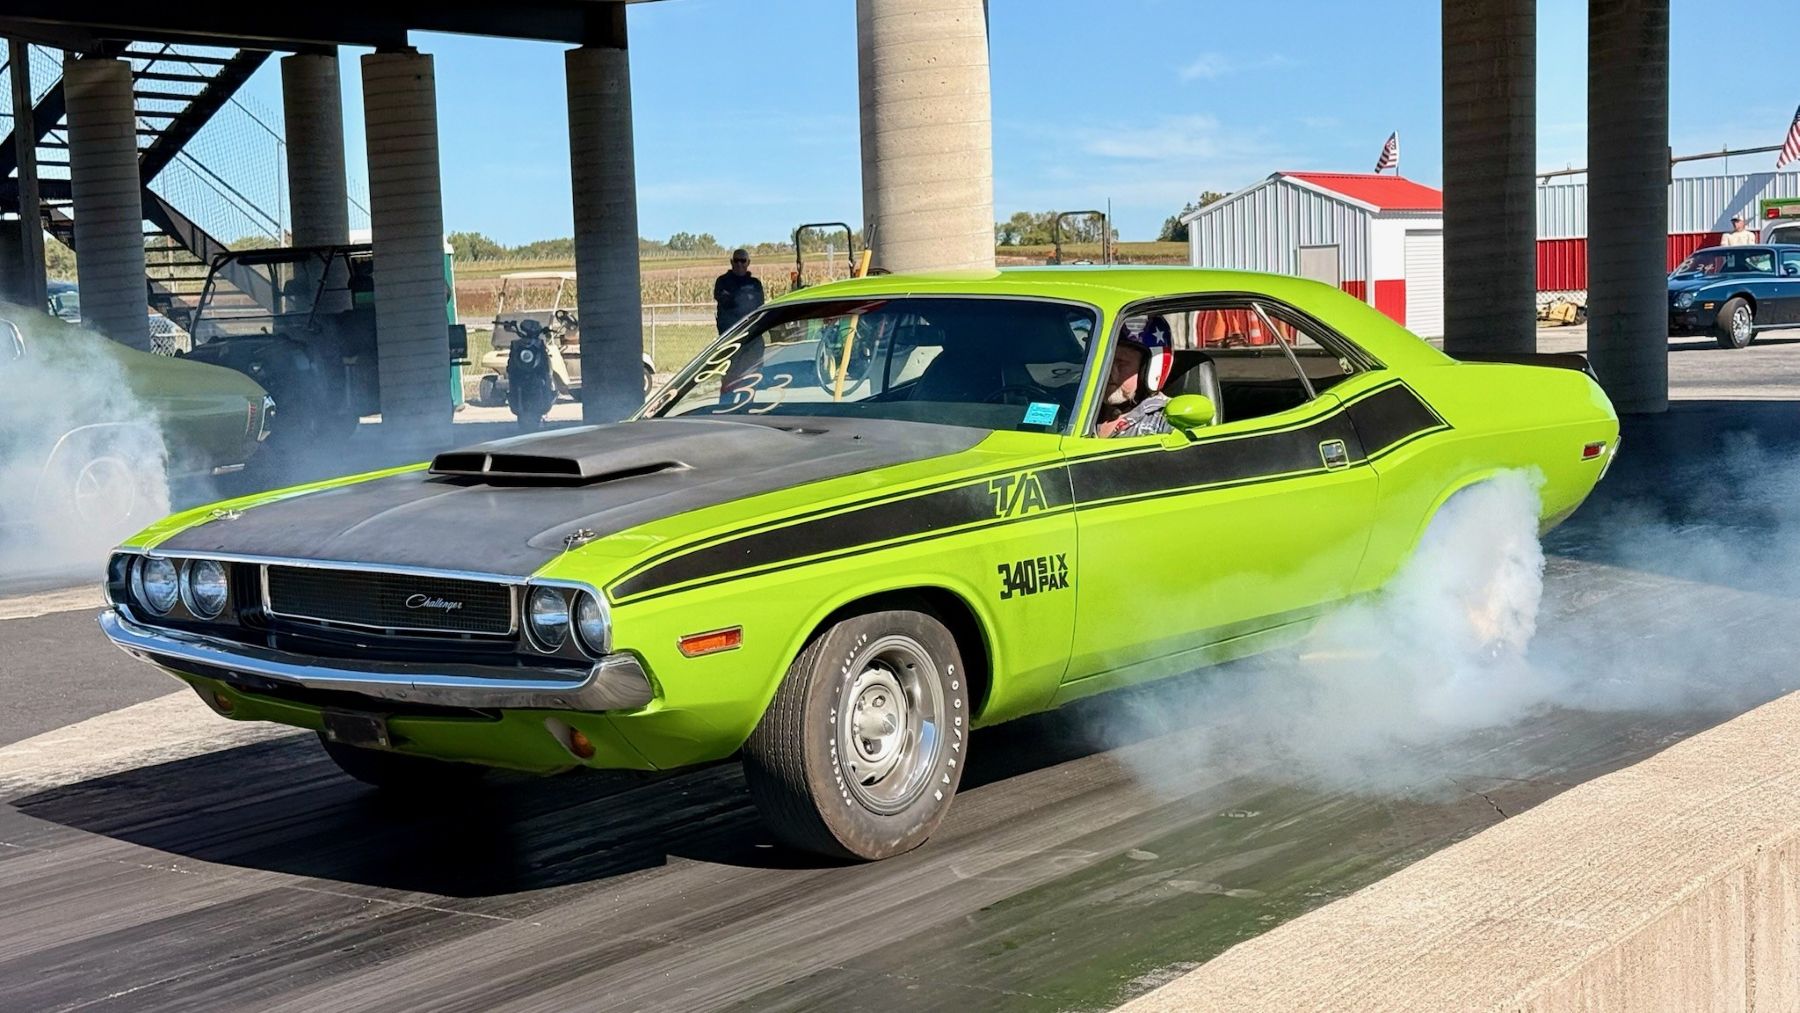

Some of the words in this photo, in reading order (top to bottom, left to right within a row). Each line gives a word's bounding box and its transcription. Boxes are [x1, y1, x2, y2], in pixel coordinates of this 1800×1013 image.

[989, 472, 1048, 518] T/A
[998, 559, 1037, 600] 340
[1037, 553, 1068, 575] SIX
[1039, 571, 1069, 592] PAK
[406, 594, 462, 613] Challenger
[934, 664, 961, 800] GOODYEAR
